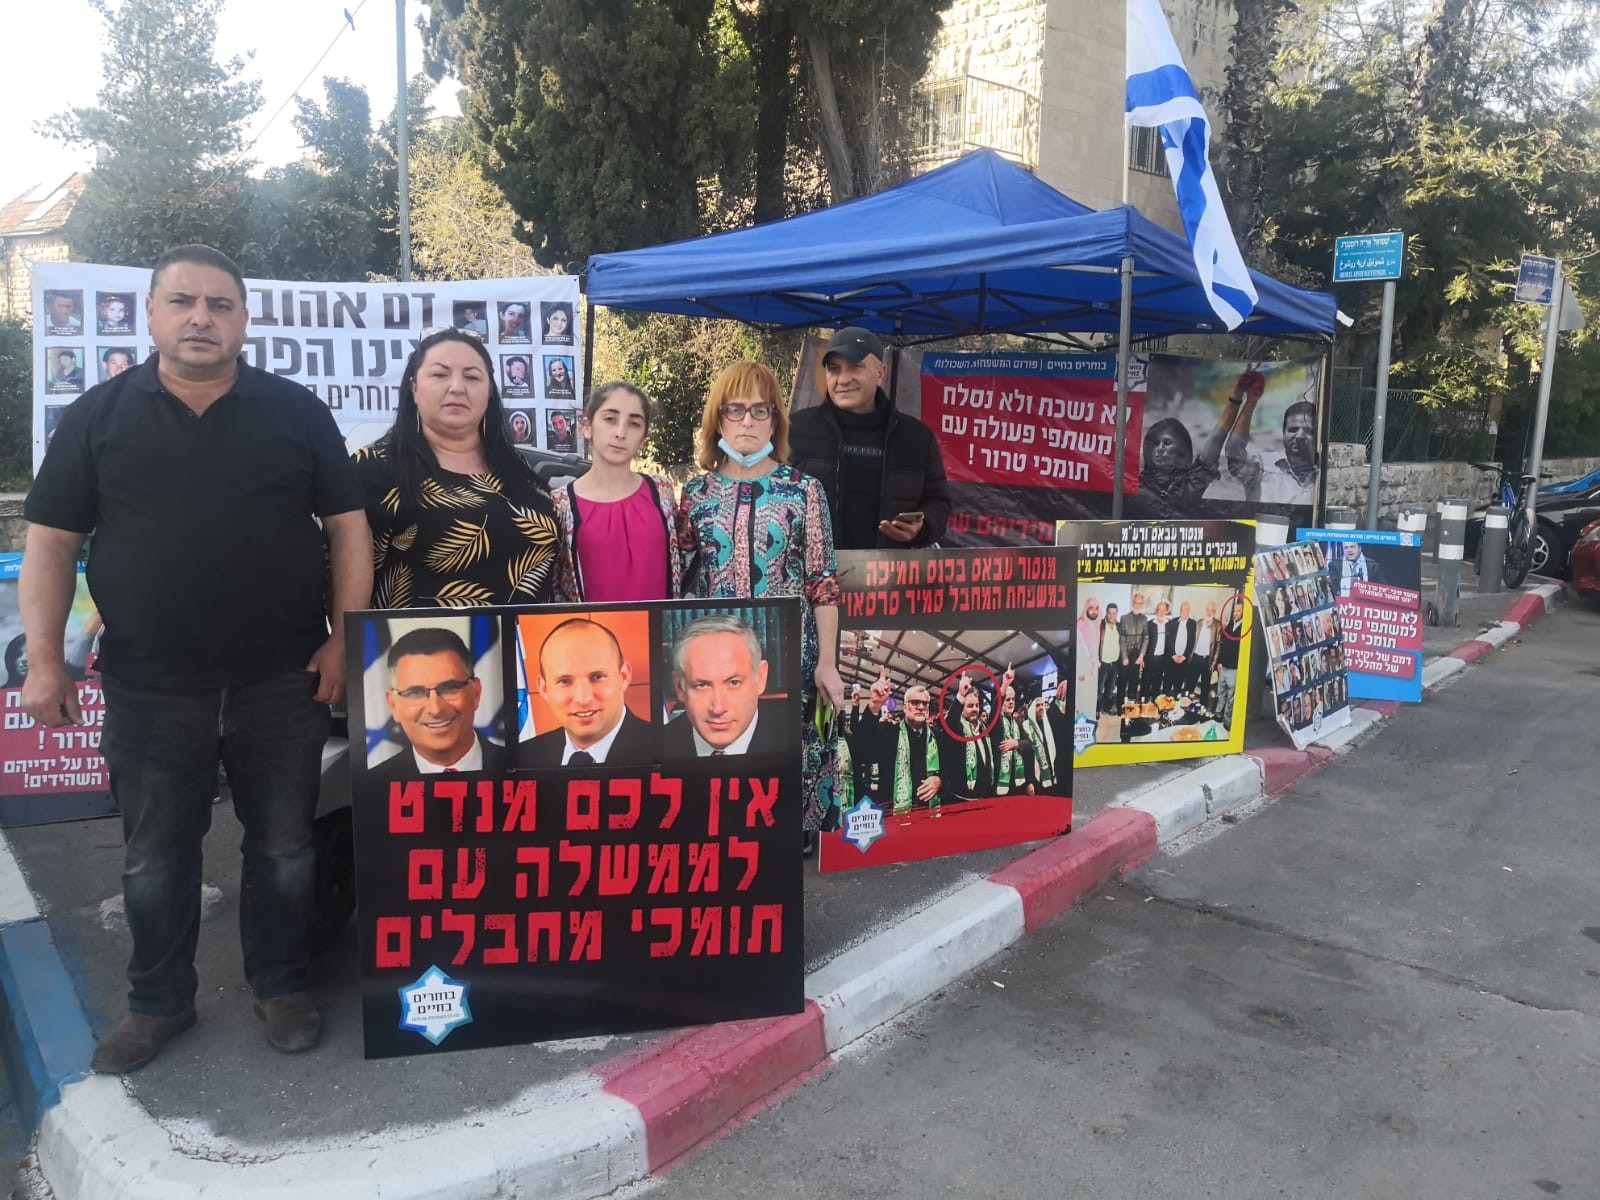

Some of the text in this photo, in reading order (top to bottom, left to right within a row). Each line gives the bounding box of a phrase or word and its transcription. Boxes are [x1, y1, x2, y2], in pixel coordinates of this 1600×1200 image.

[250, 288, 436, 330] דם אהוב
[238, 336, 335, 376] הפק
[934, 358, 970, 369] השכולות
[1013, 360, 1038, 370] פורום
[1047, 360, 1073, 371] בחיים
[1075, 360, 1107, 371] בוחרים
[943, 383, 994, 410] נסלח
[998, 388, 1034, 415] ולא
[1038, 396, 1095, 423] נשכח
[941, 414, 1127, 456] משתפי פעולה עם
[981, 448, 1027, 473] טרור
[1033, 455, 1089, 482] תומכי
[1151, 527, 1177, 541] עבאס
[1179, 527, 1204, 541] מנסור
[1107, 541, 1141, 557] המחבל
[1143, 542, 1178, 557] משפחת
[1180, 542, 1203, 556] בבית
[1205, 542, 1238, 557] מבקרים
[865, 556, 1057, 586] מנסור עבאס בכנס תמיכה
[1095, 559, 1127, 574] בצומת
[1130, 557, 1170, 572] ישראלים
[1181, 557, 1206, 571] ברצח
[1209, 556, 1247, 573] שהשתתף
[841, 585, 1066, 617] במשפחת המחבל סמיר סרסאוי
[1339, 603, 1418, 624] לא נשכח ולא
[1340, 617, 1417, 638] למשתפי פעו
[1342, 631, 1397, 649] תומכי טר
[1376, 650, 1390, 662] של
[1392, 655, 1412, 666] דמם
[1355, 658, 1382, 671] מהללי
[1385, 661, 1399, 673] של
[4, 712, 36, 730] עם
[52, 731, 102, 749] טרור
[4, 759, 56, 774] ידייהם
[60, 755, 82, 770] על
[24, 772, 102, 788] השהידים!
[389, 772, 779, 836] אין לכם מנדט
[851, 813, 878, 823] בוחרים
[853, 822, 875, 831] בחיים
[408, 835, 760, 900] לממשלה עם
[376, 903, 783, 968] תומכי מחבלים
[413, 990, 456, 1003] בוחרים
[417, 1002, 452, 1014] בחיים
